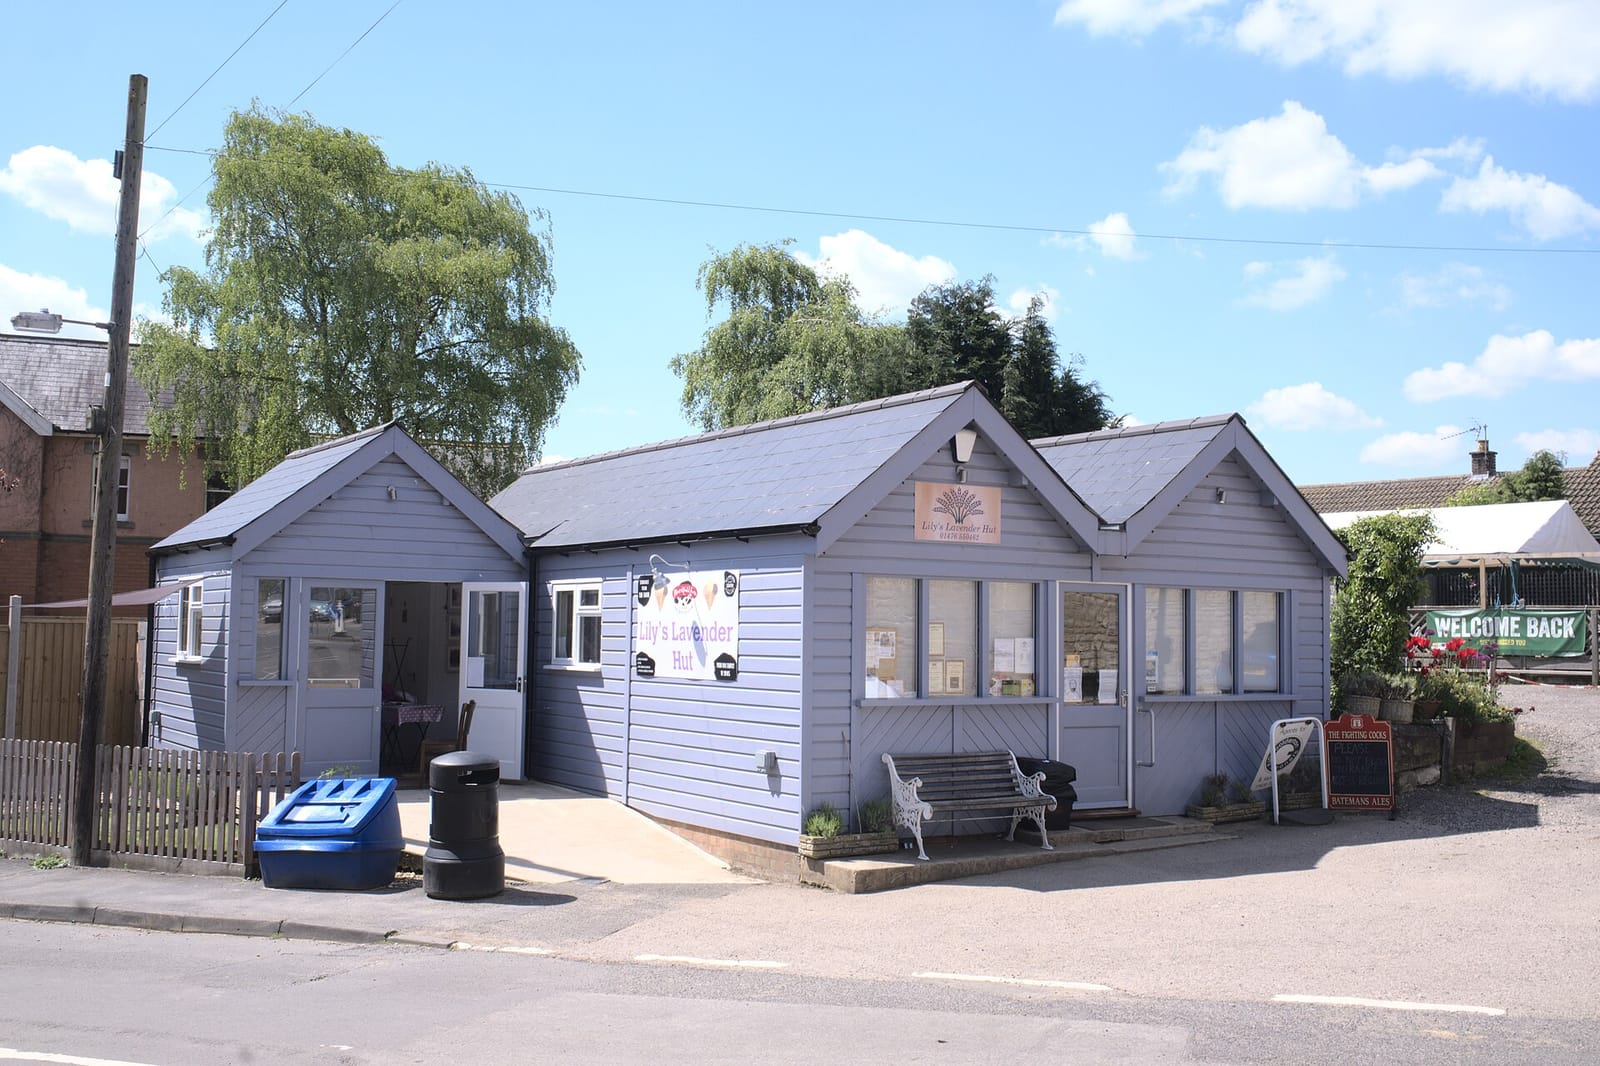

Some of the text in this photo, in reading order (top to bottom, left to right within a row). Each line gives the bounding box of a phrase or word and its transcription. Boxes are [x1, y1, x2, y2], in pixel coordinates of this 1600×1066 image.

[922, 521, 996, 534] Lily's Lavender Hut
[639, 621, 734, 645] Lily's Lavender
[1434, 616, 1575, 638] WELCOME BACK
[672, 650, 694, 671] Hut
[1328, 731, 1387, 739] THE FIGHTING COCKS
[1331, 797, 1390, 806] BATEMANS ALES
